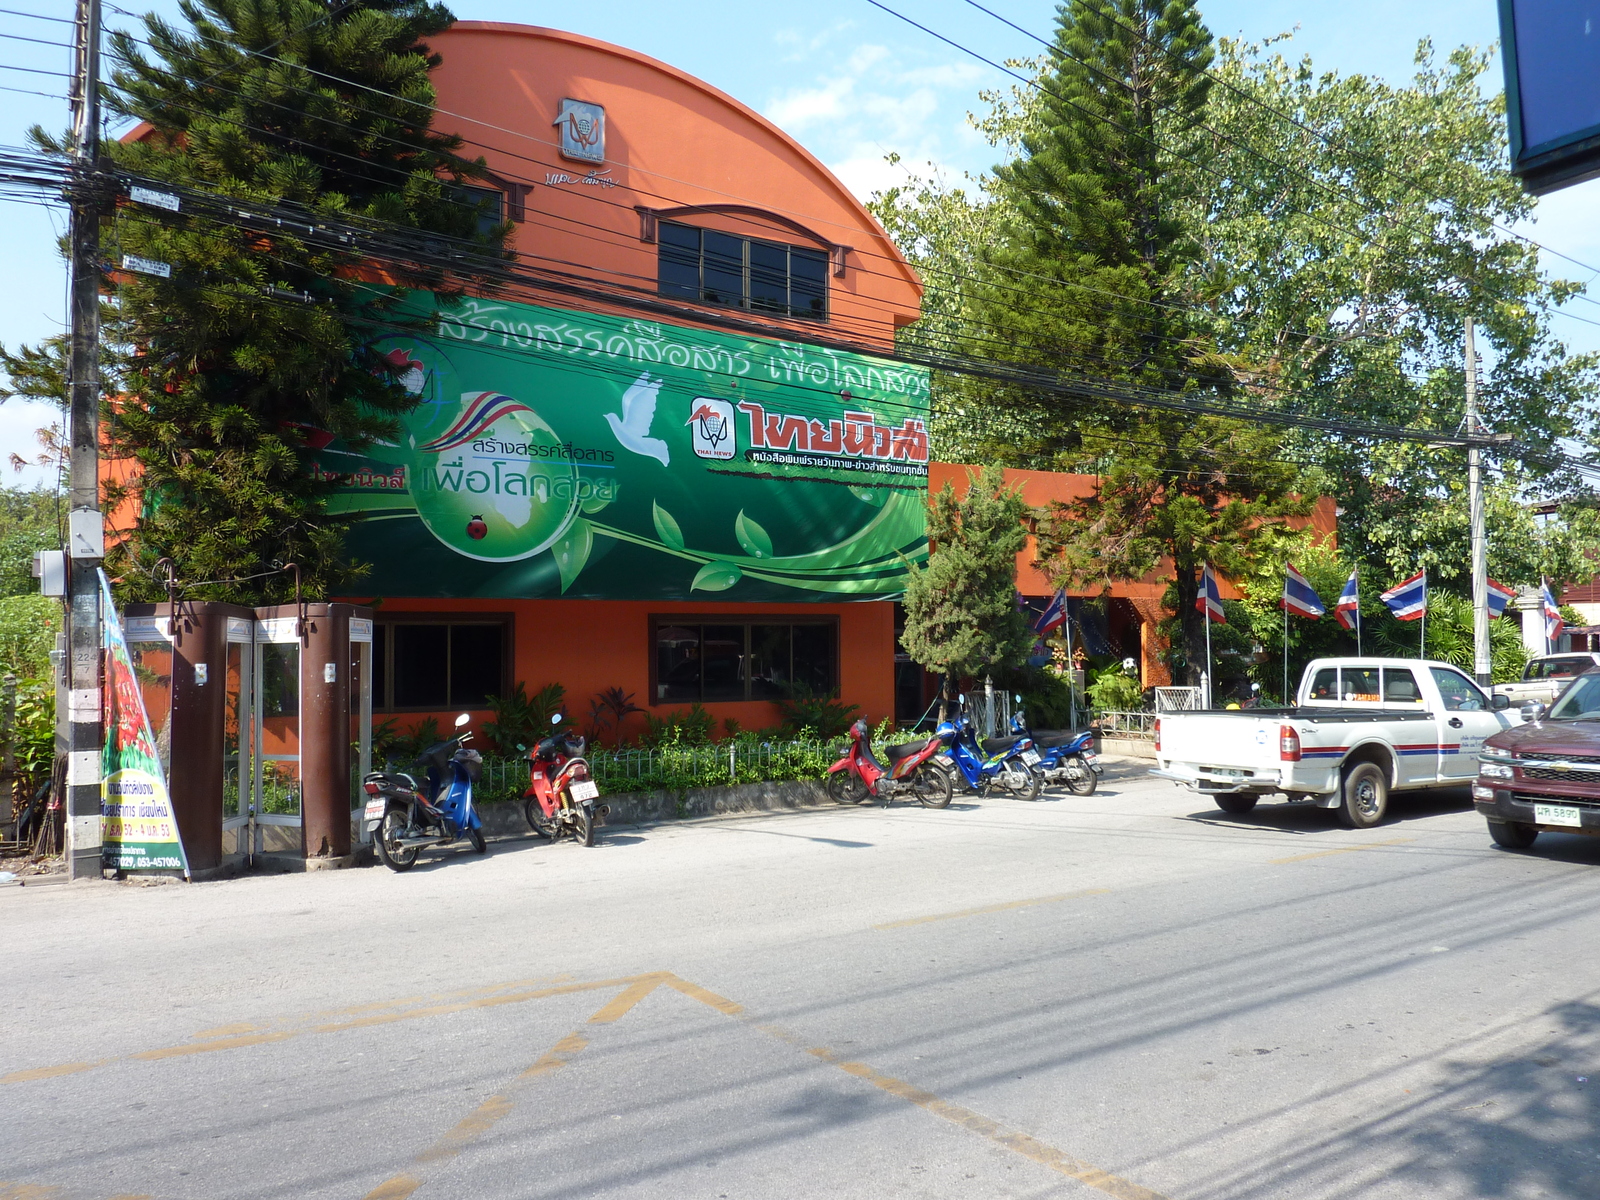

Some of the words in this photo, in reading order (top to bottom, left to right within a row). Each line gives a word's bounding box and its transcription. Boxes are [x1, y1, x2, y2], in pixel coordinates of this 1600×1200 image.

[736, 399, 929, 464] ไทยนิวส์
[472, 437, 615, 462] สร้างสรรค์สื่อสาร
[422, 456, 617, 501] เพื่อโลกสวย
[1553, 808, 1578, 819] 5890
[137, 857, 182, 868] 053-457006
